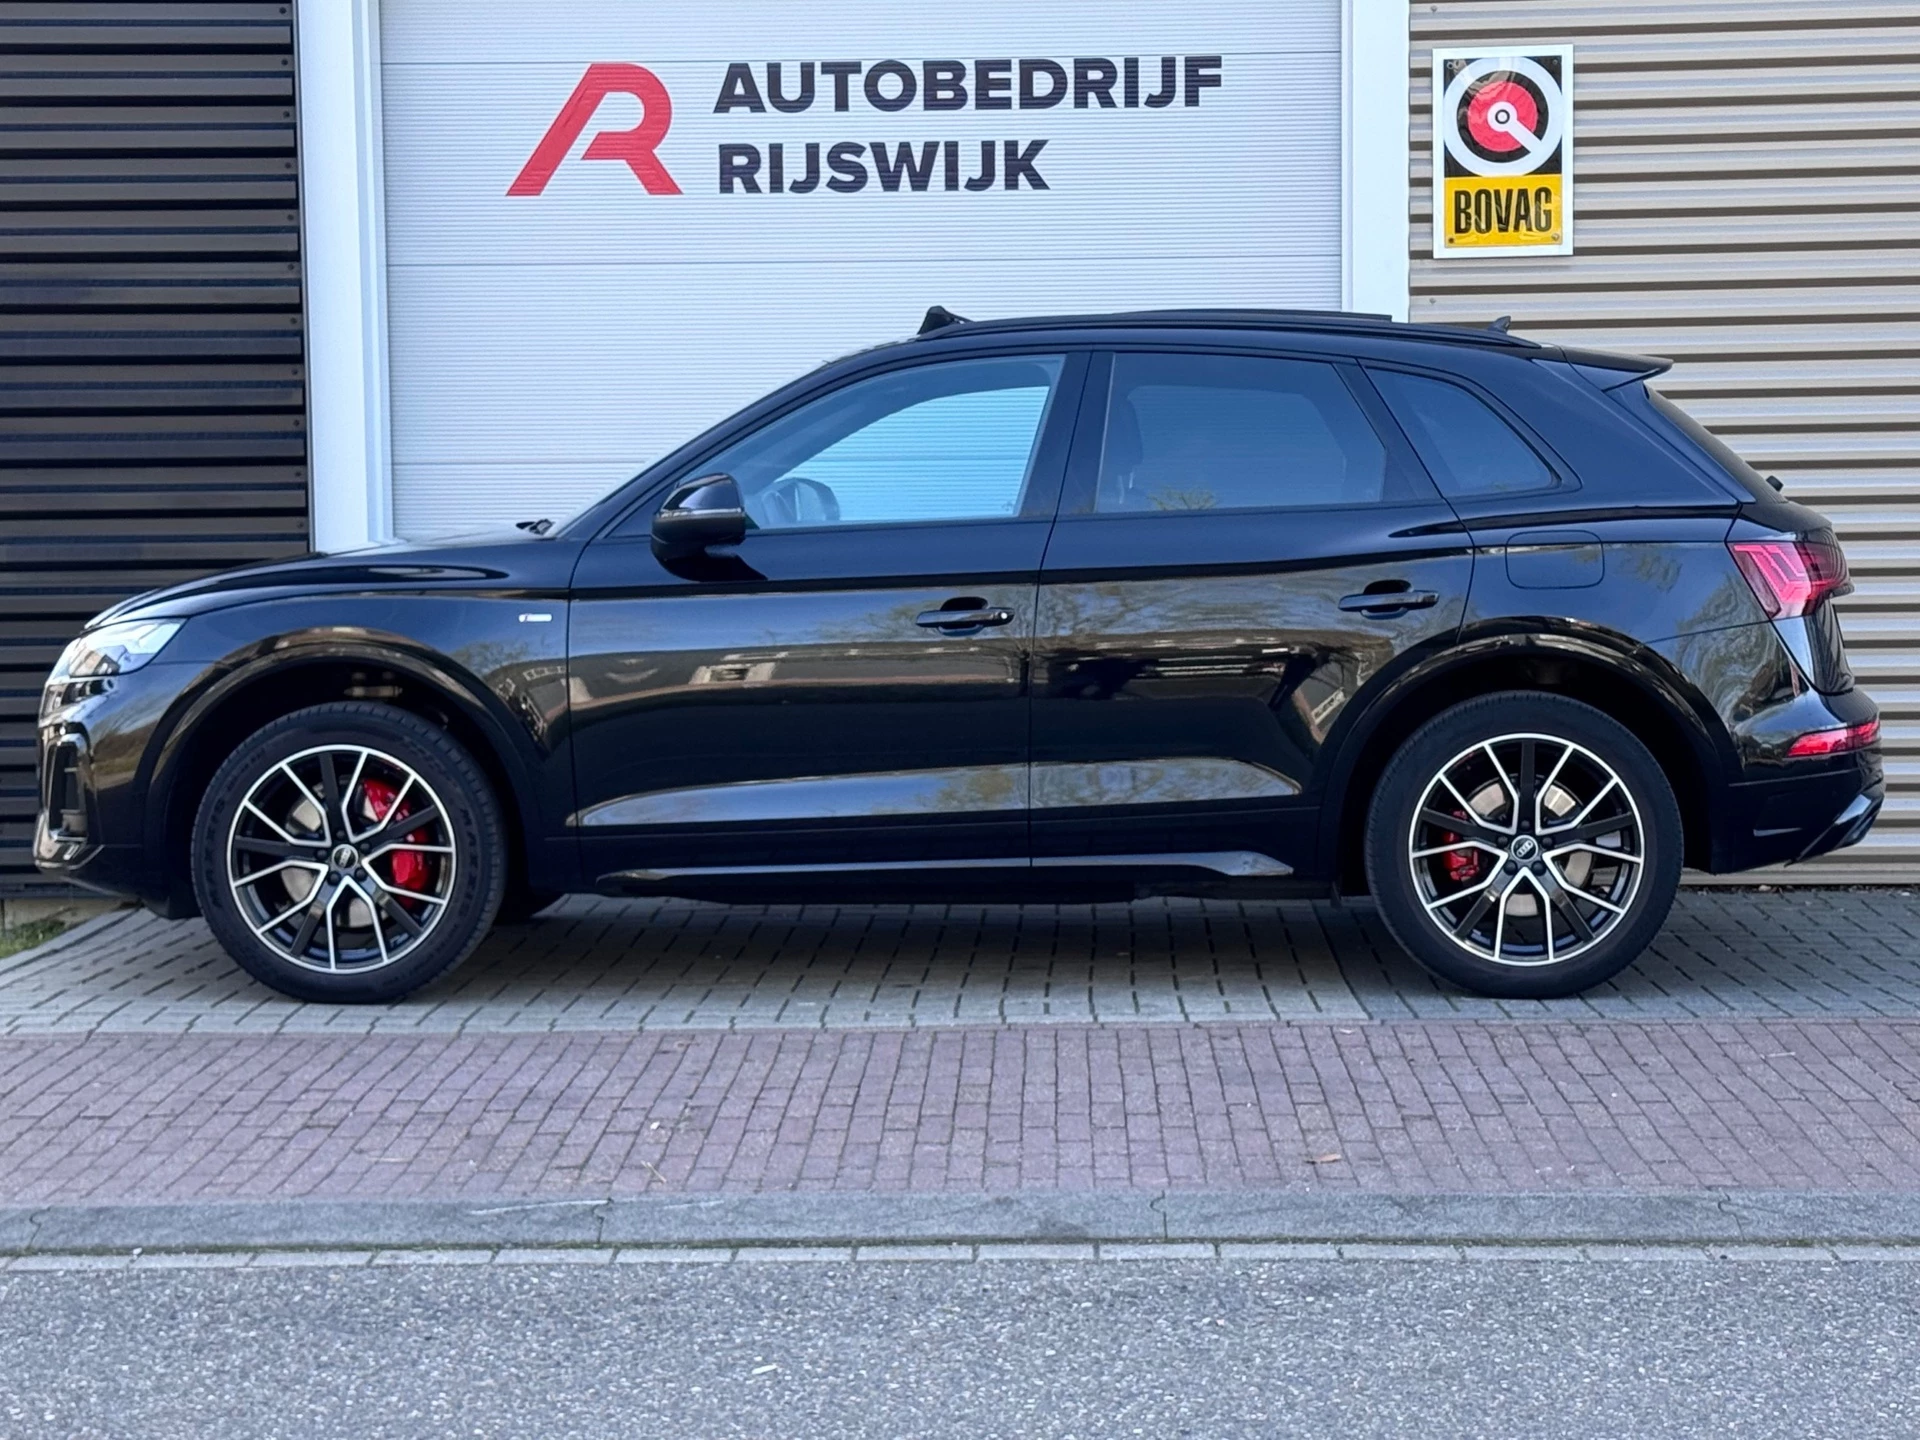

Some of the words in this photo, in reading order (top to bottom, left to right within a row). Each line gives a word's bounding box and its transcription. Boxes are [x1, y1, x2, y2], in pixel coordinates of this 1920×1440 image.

[713, 55, 1222, 114] AUTOBEDRIJF
[718, 139, 1051, 195] RIJSWIJK
[1454, 186, 1552, 235] BOVAG
